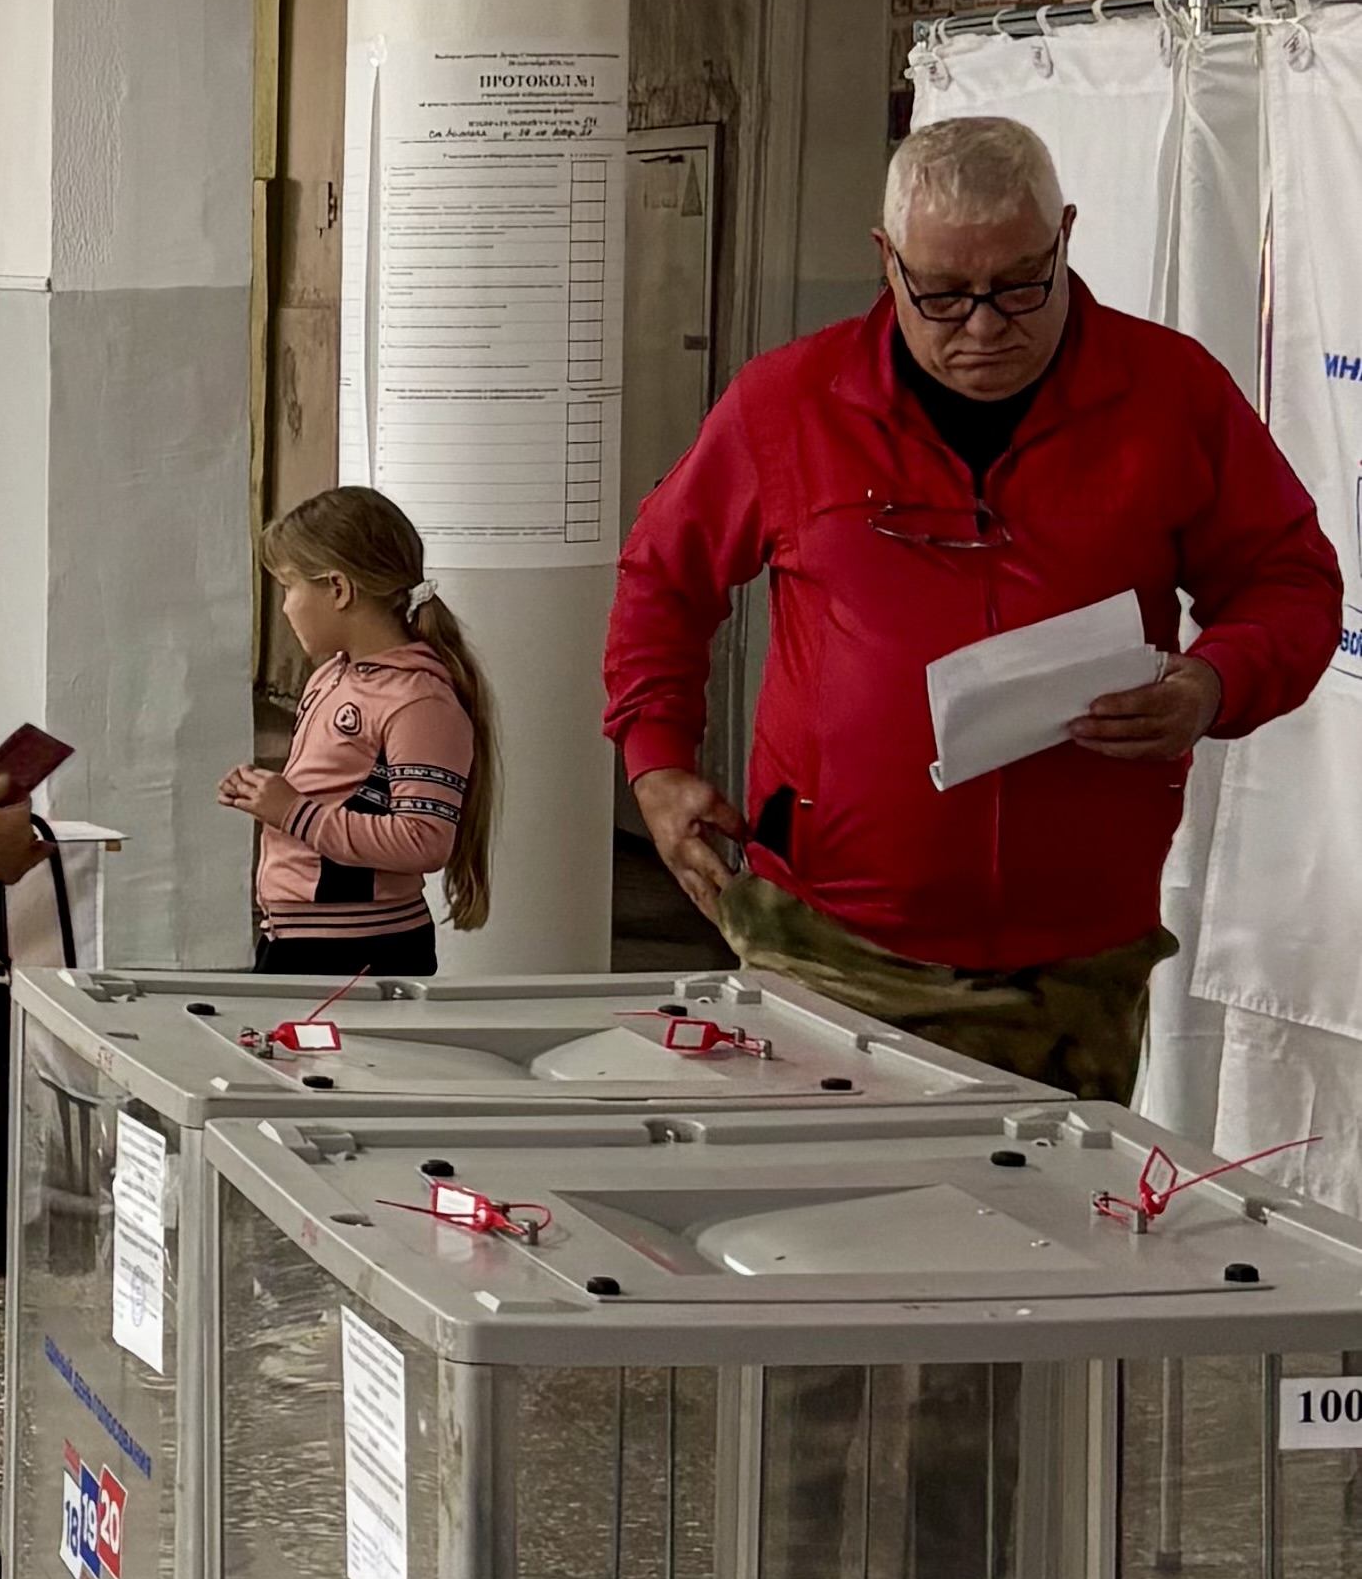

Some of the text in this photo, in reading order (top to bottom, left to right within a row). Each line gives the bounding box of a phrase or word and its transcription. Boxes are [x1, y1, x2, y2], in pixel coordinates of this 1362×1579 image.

[479, 75, 595, 88] ПРОТОКОЛ № 1
[65, 1499, 78, 1557] 18
[82, 1492, 97, 1552] 19
[100, 1489, 120, 1554] 20
